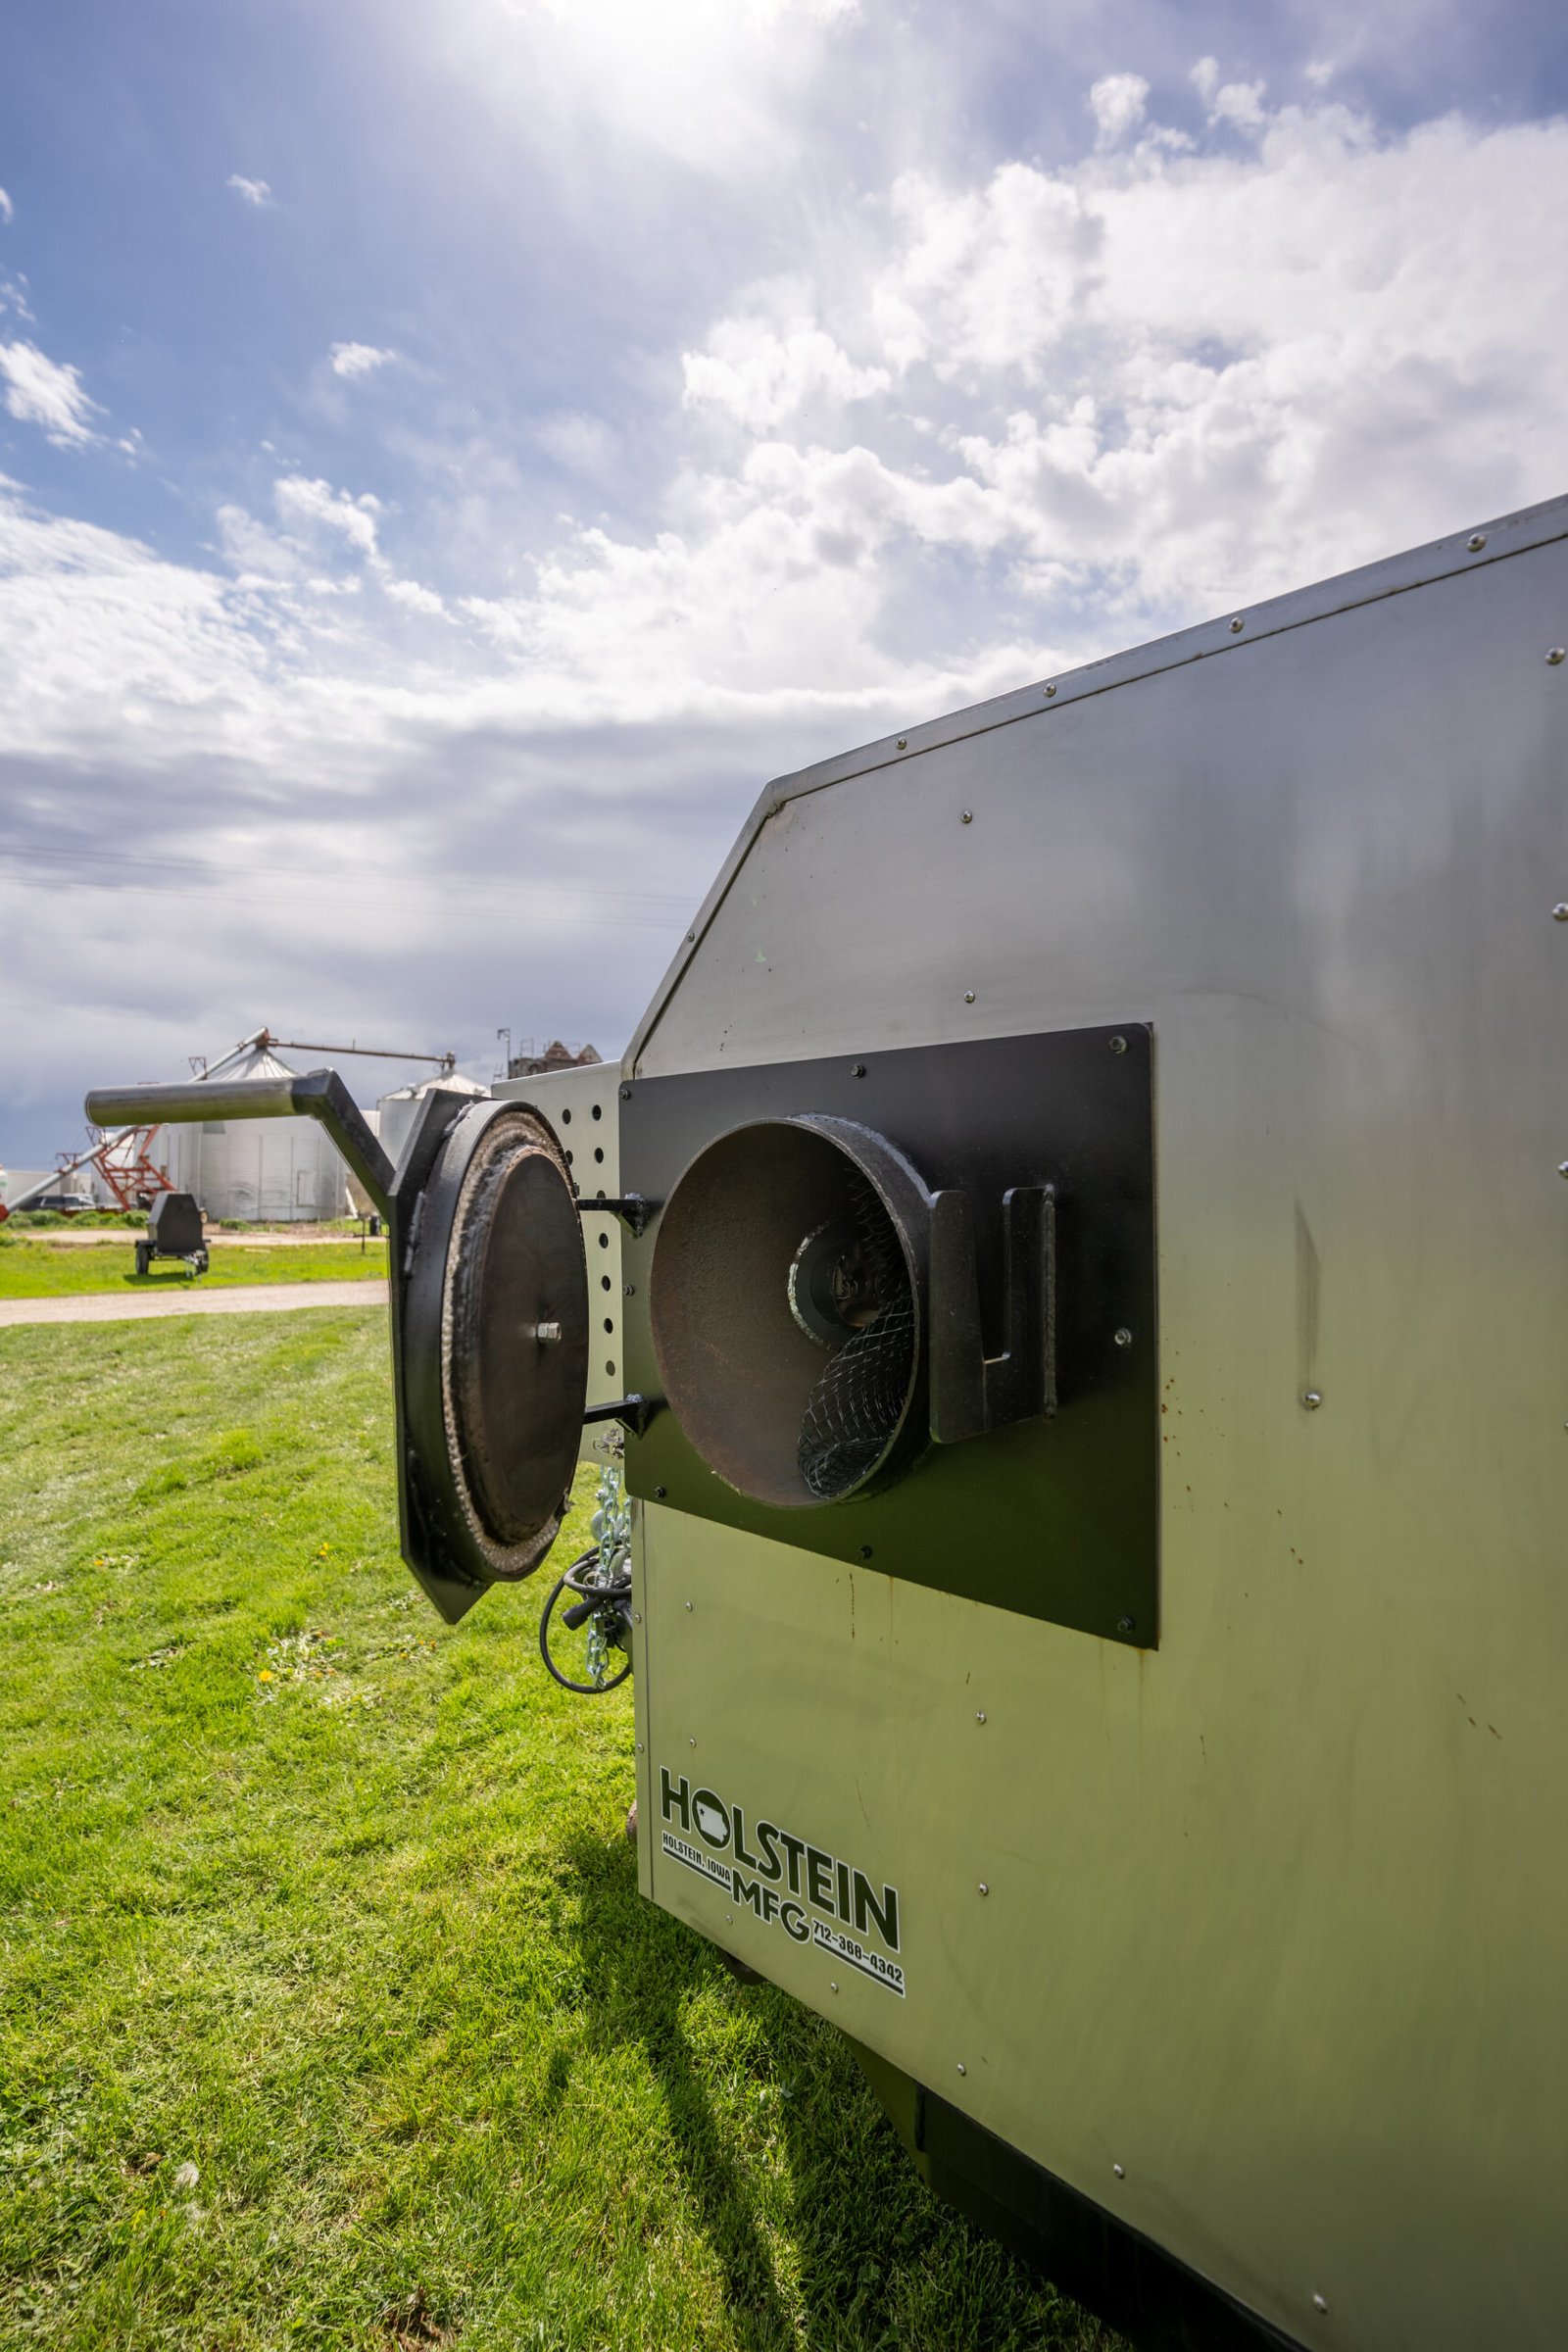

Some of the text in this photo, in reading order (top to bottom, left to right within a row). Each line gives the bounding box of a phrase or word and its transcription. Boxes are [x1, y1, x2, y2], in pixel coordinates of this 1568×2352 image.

[661, 1767, 899, 1951] HOLSTEIN
[662, 1832, 731, 1882] HOLSTEIN, IOWA
[733, 1869, 810, 1942] MFG
[812, 1919, 904, 1984] 712-368-4342
